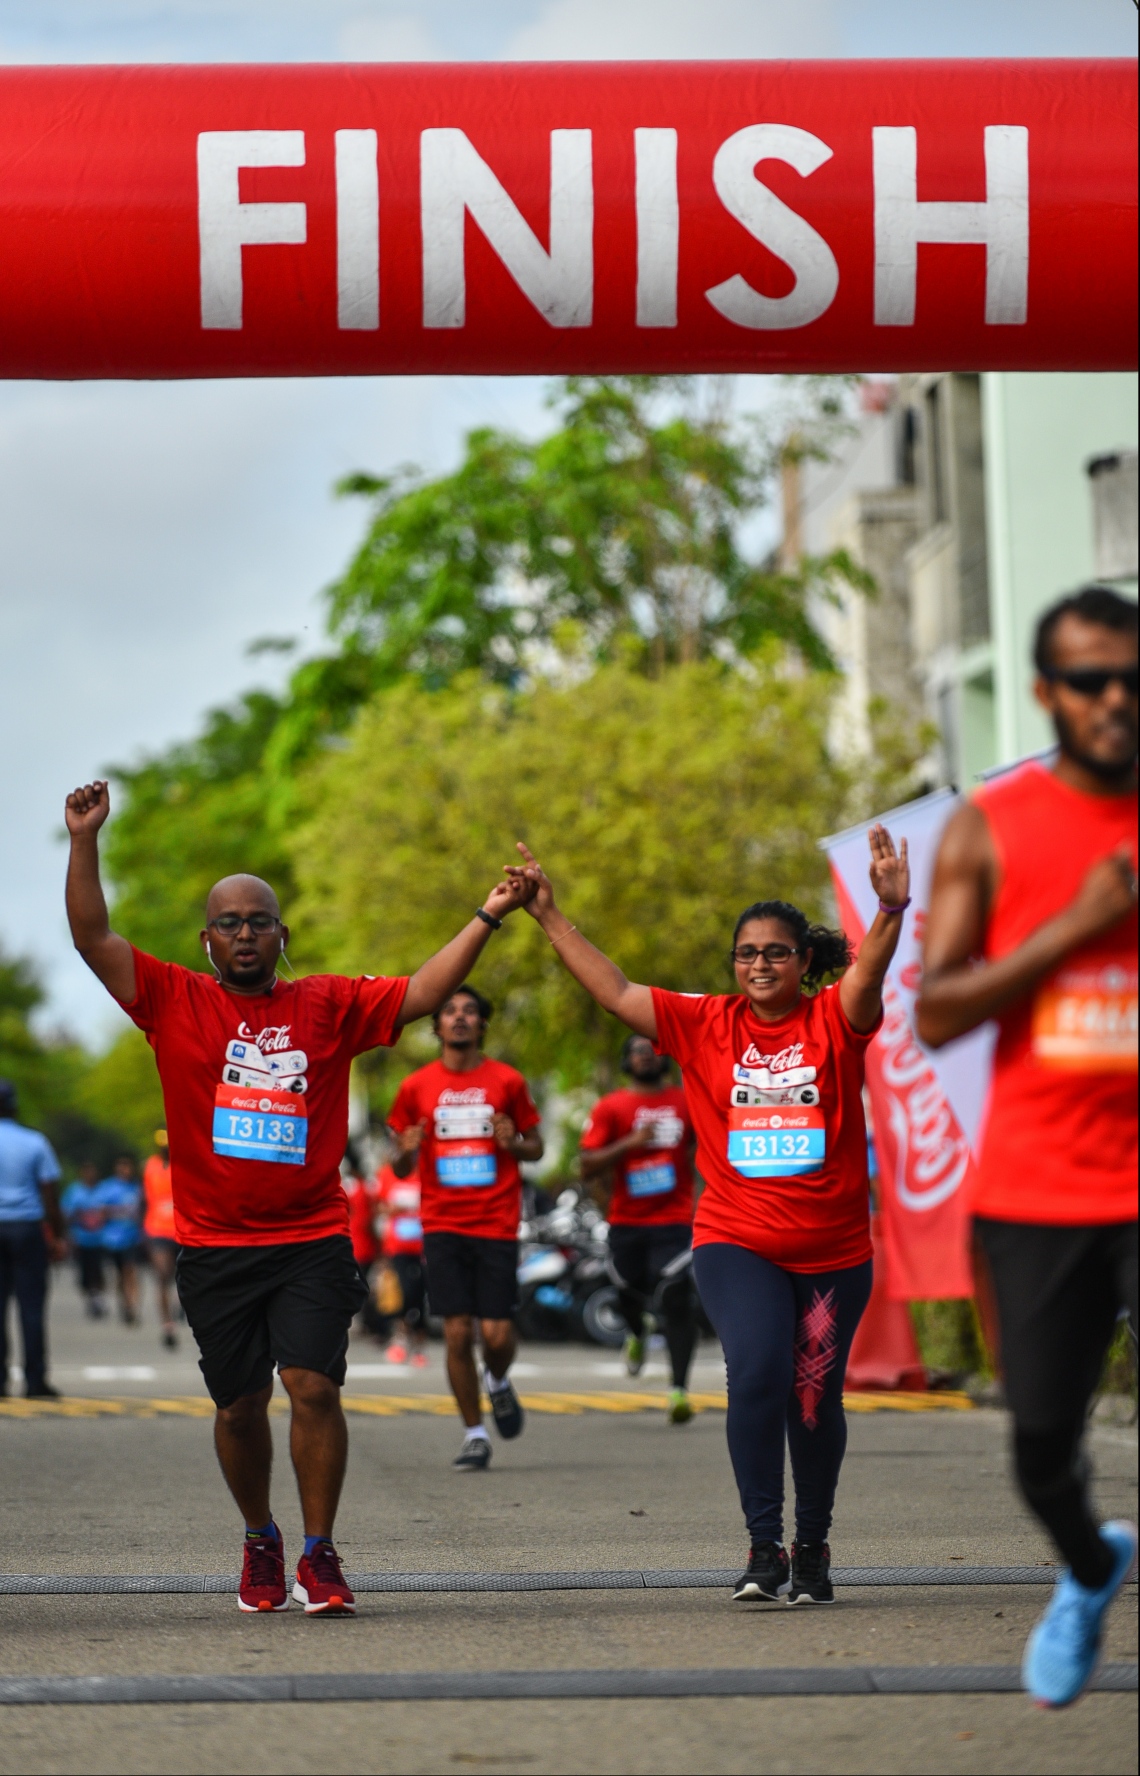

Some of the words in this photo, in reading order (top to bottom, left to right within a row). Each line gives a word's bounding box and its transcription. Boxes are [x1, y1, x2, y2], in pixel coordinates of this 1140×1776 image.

[198, 123, 1029, 330] FINISH
[229, 1115, 295, 1143] T3133
[742, 1134, 810, 1157] T3132
